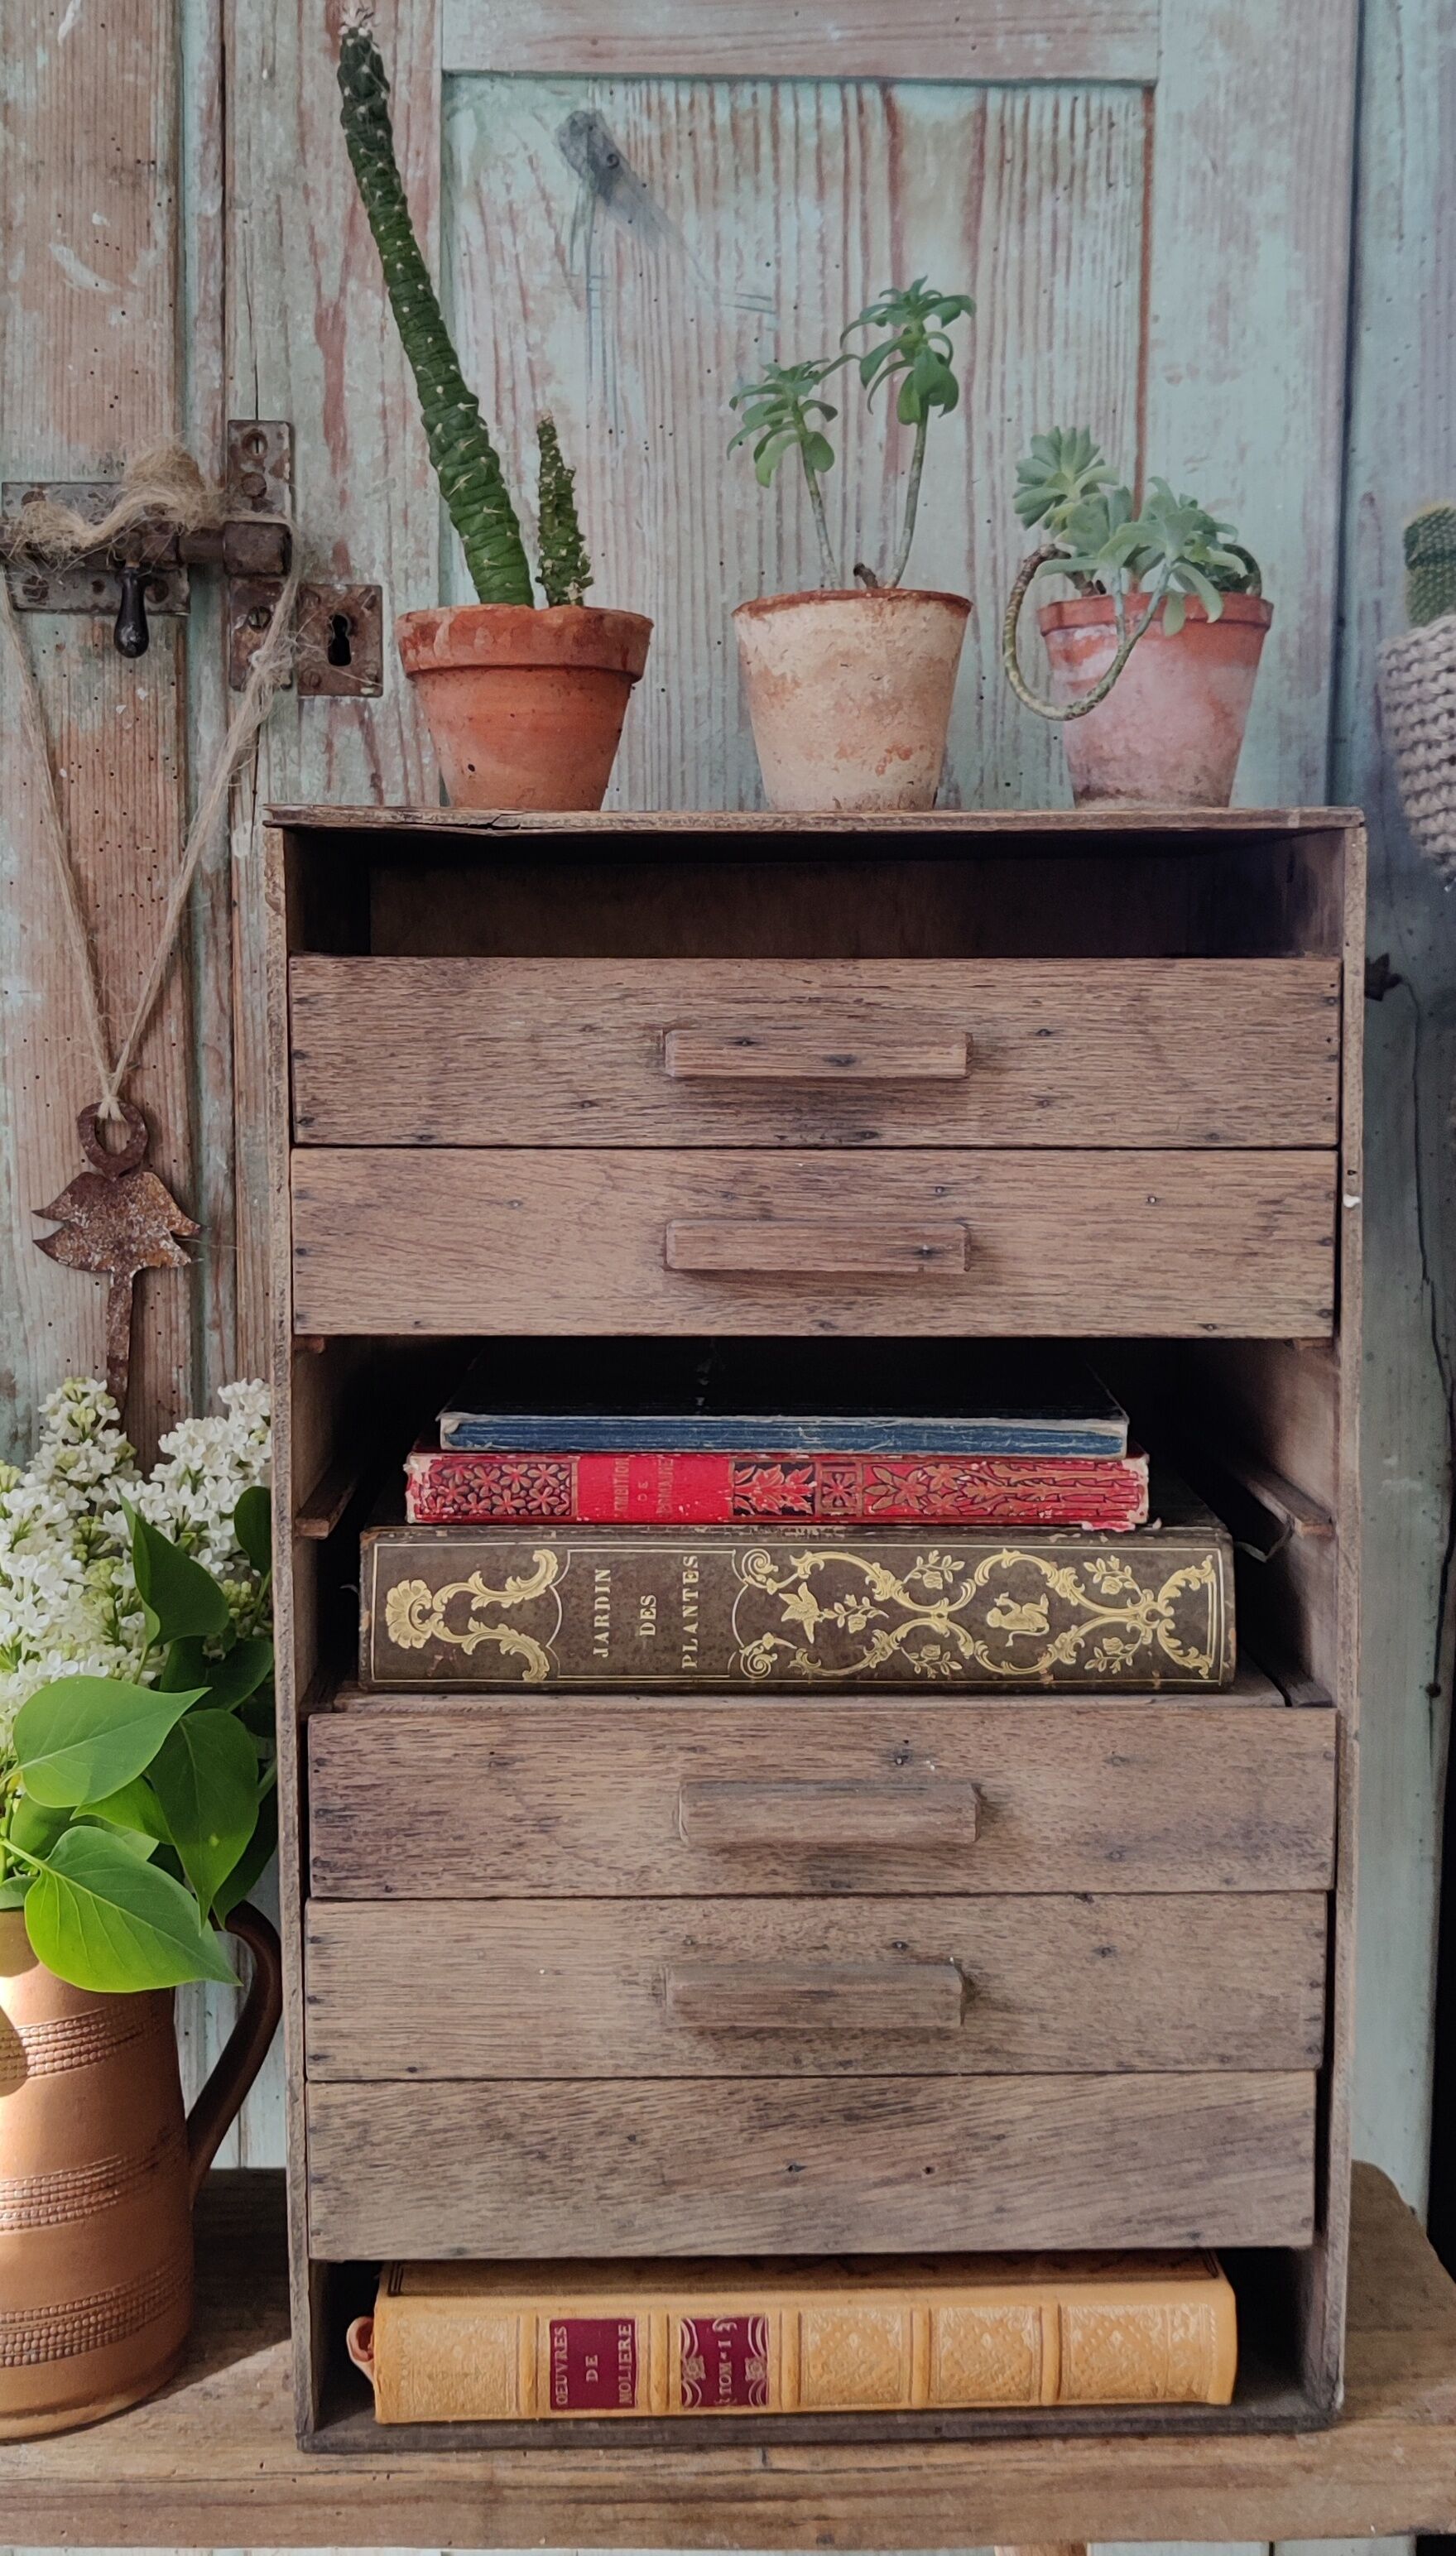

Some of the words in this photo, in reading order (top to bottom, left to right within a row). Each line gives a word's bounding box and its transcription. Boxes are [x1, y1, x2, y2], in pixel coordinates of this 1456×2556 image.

[593, 1569, 611, 1658] JARDIN
[639, 1594, 656, 1636] DES
[681, 1555, 699, 1669] PLANTES
[584, 2354, 598, 2382] DE
[617, 2323, 632, 2404] MOLIERE
